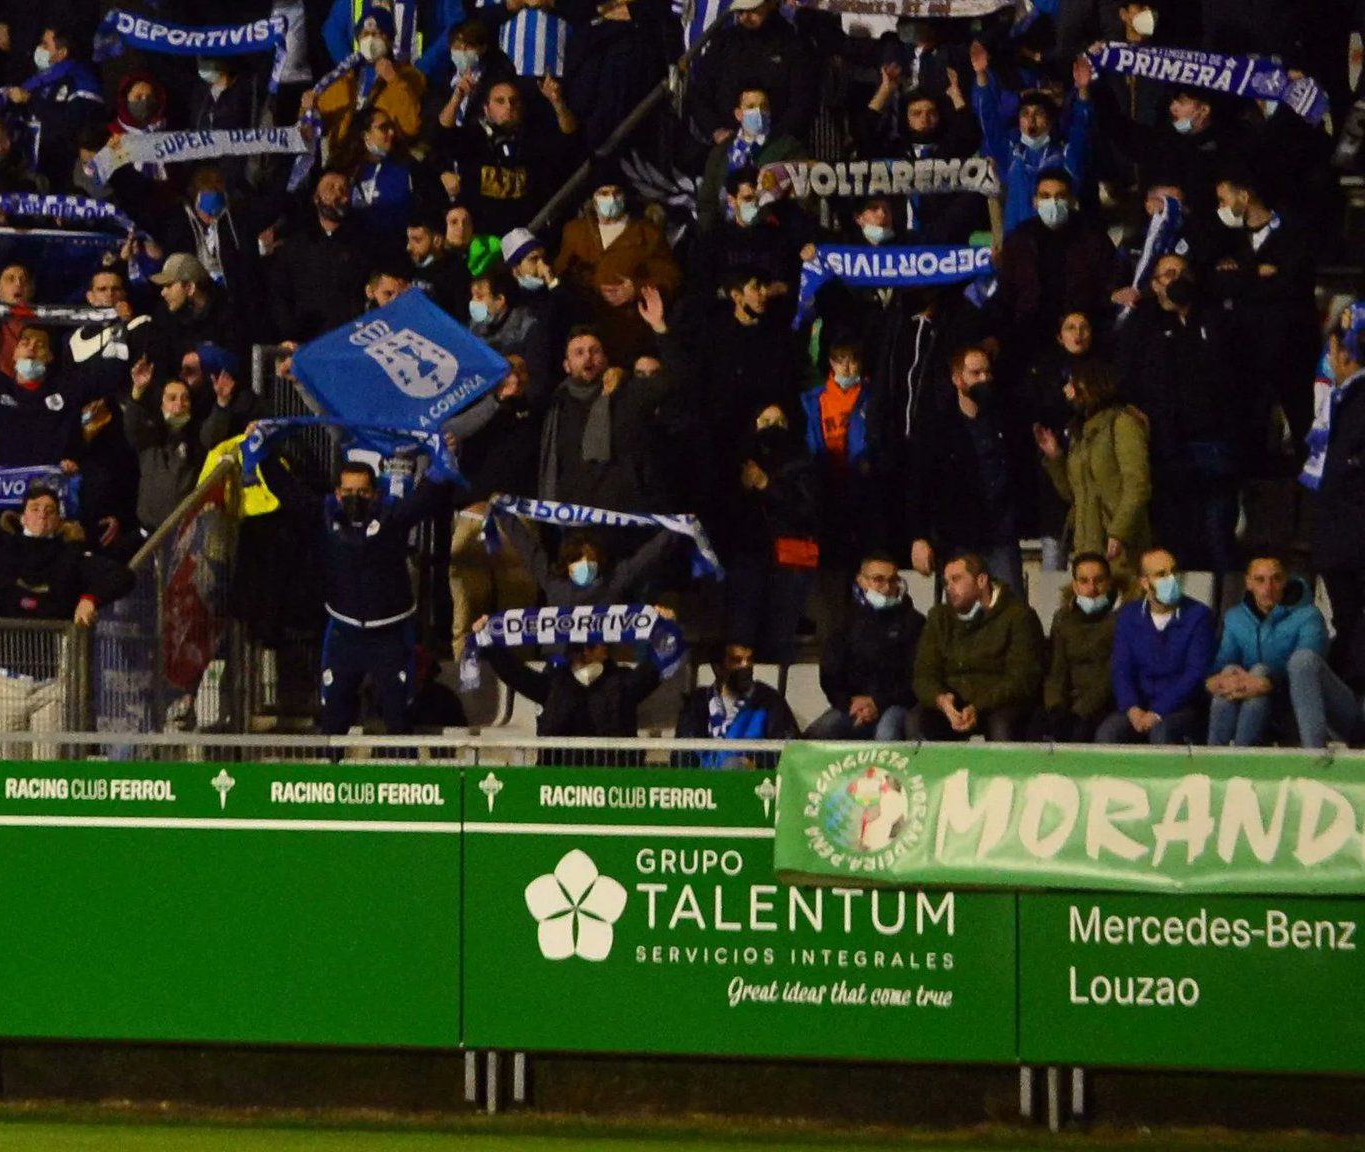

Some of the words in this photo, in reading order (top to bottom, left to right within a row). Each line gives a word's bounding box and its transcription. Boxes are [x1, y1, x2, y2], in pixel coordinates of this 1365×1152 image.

[1117, 50, 1235, 90] PRIMERA
[154, 128, 215, 158] SUPER
[825, 247, 992, 277] DEPORTIVIS
[506, 613, 653, 636] DEPORTIVO
[5, 777, 68, 801] RACING
[69, 778, 108, 801] CLUB
[110, 778, 175, 803] FERROL
[270, 781, 335, 804] RACING
[337, 781, 375, 804] CLUB
[377, 782, 444, 806] FERROL
[539, 785, 606, 808] RACING
[608, 785, 646, 808] CLUB
[649, 786, 717, 810] FERROL
[933, 768, 1365, 868] MORAND
[636, 848, 743, 876] GRUPO
[636, 883, 955, 936] TALENTUM
[1069, 905, 1357, 951] Mercedes-Benz
[635, 945, 775, 966] SERVICIOS
[790, 949, 955, 970] INTEGRALES
[727, 976, 778, 1008] Great
[781, 980, 827, 1005] ideas
[831, 979, 867, 1005] that
[870, 988, 912, 1007] come
[915, 985, 953, 1008] true
[1069, 965, 1200, 1007] Louzao
